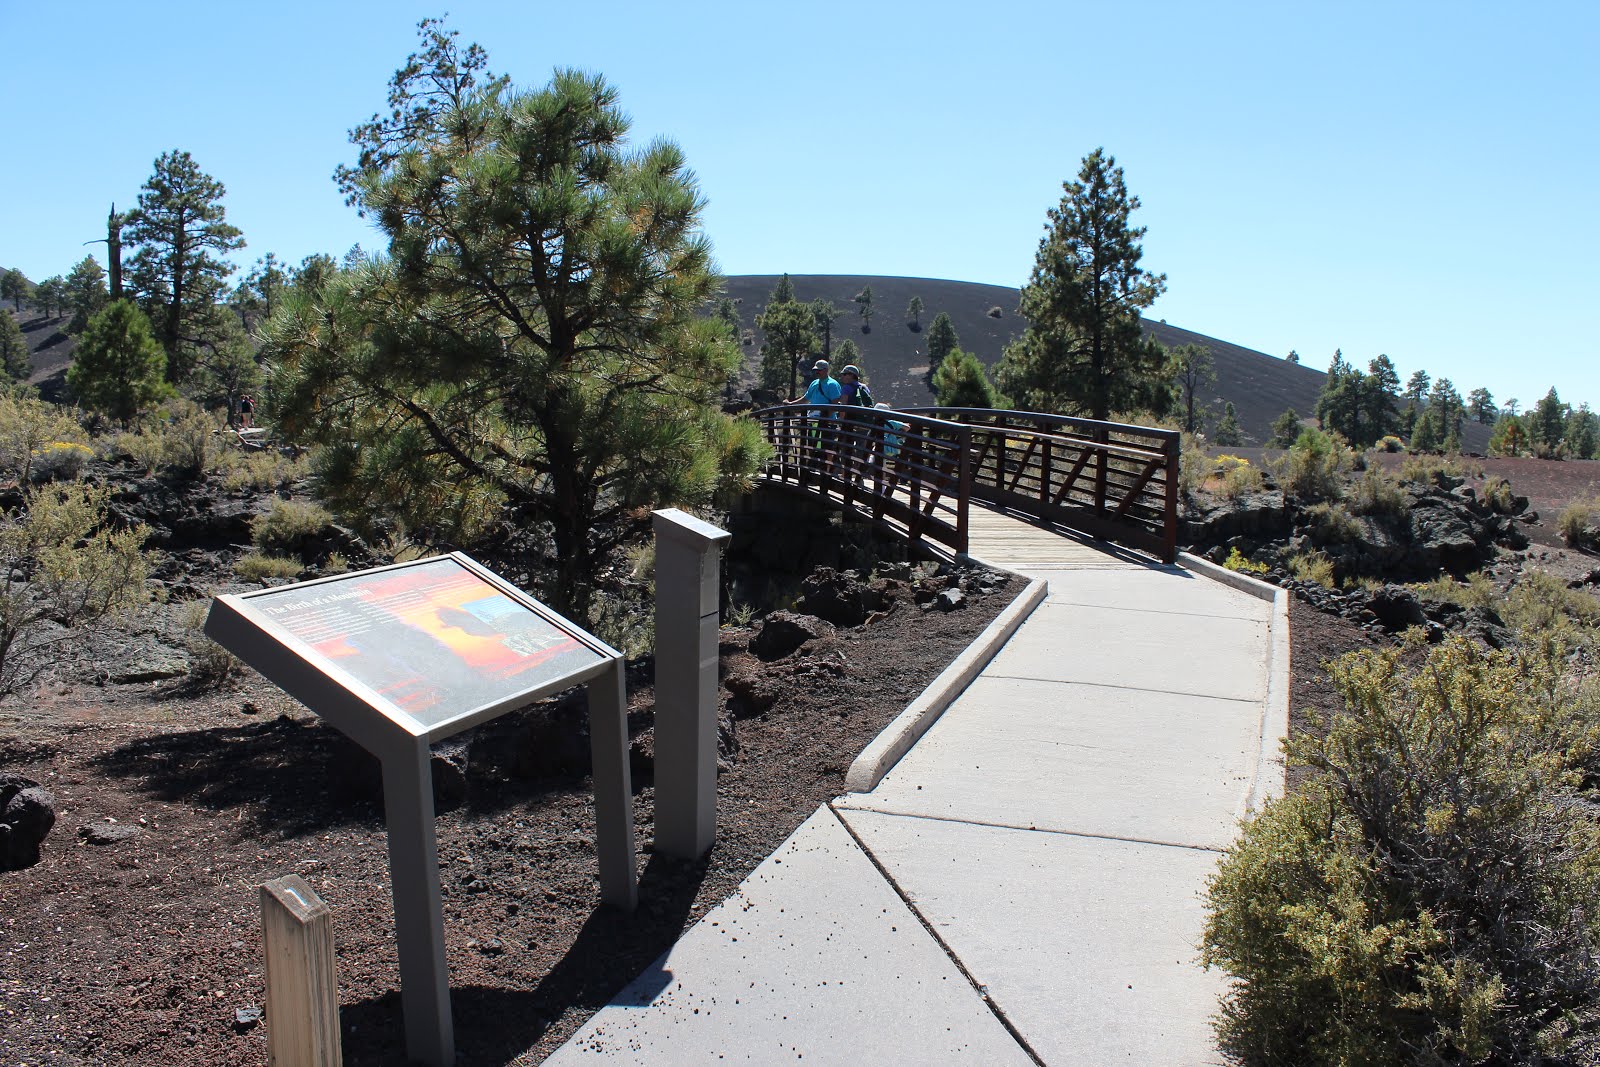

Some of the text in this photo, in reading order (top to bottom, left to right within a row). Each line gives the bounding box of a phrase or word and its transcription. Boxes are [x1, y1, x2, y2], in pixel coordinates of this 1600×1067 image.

[265, 606, 285, 616] The
[285, 600, 312, 612] Birth
[312, 597, 322, 606] of
[329, 589, 371, 602] Mountain
